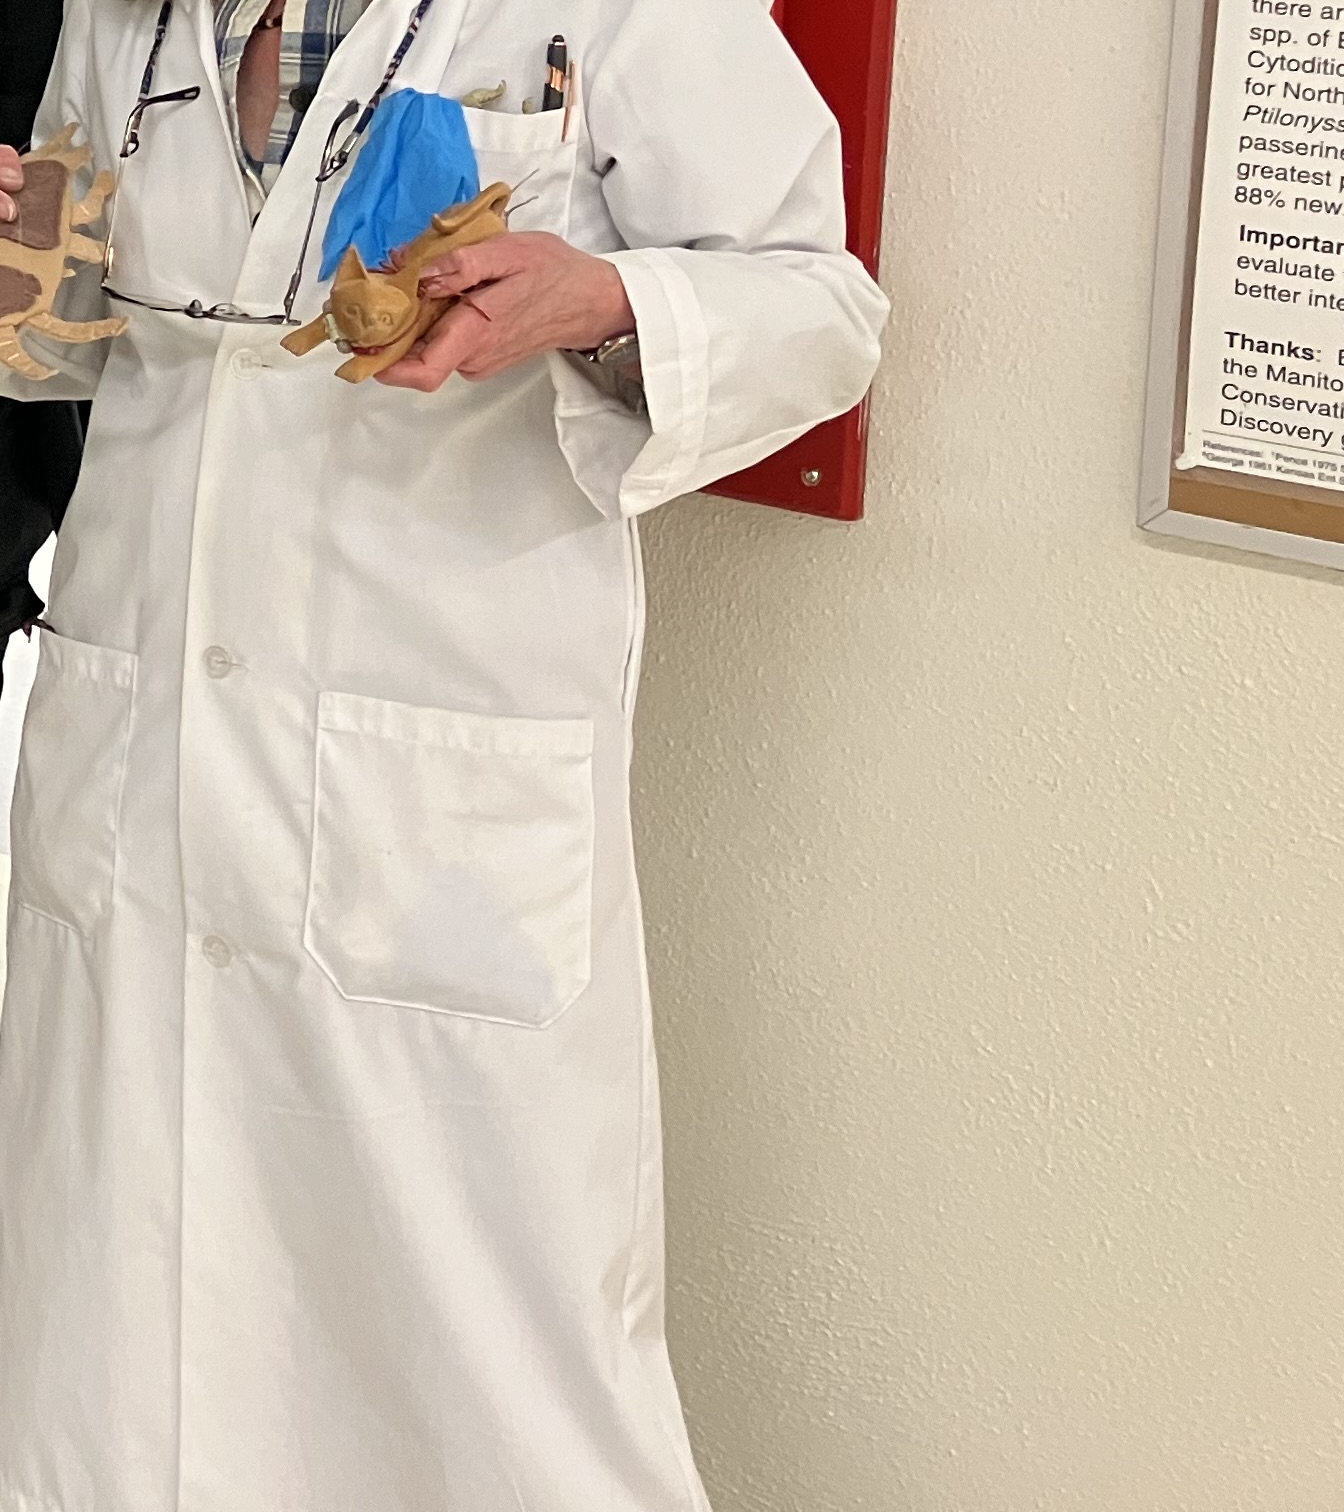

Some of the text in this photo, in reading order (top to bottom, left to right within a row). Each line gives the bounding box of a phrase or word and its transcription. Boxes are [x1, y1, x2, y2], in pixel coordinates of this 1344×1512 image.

[1249, 26, 1298, 47] spp.
[1307, 29, 1331, 48] of
[1244, 77, 1276, 97] for
[1236, 162, 1331, 187] greatest
[1234, 185, 1286, 208] 88%
[1236, 255, 1335, 282] evaluate
[1234, 278, 1301, 303] better
[1224, 331, 1321, 363] Thanks:
[1222, 357, 1344, 392] the Manito
[1220, 408, 1333, 447] Discovery
